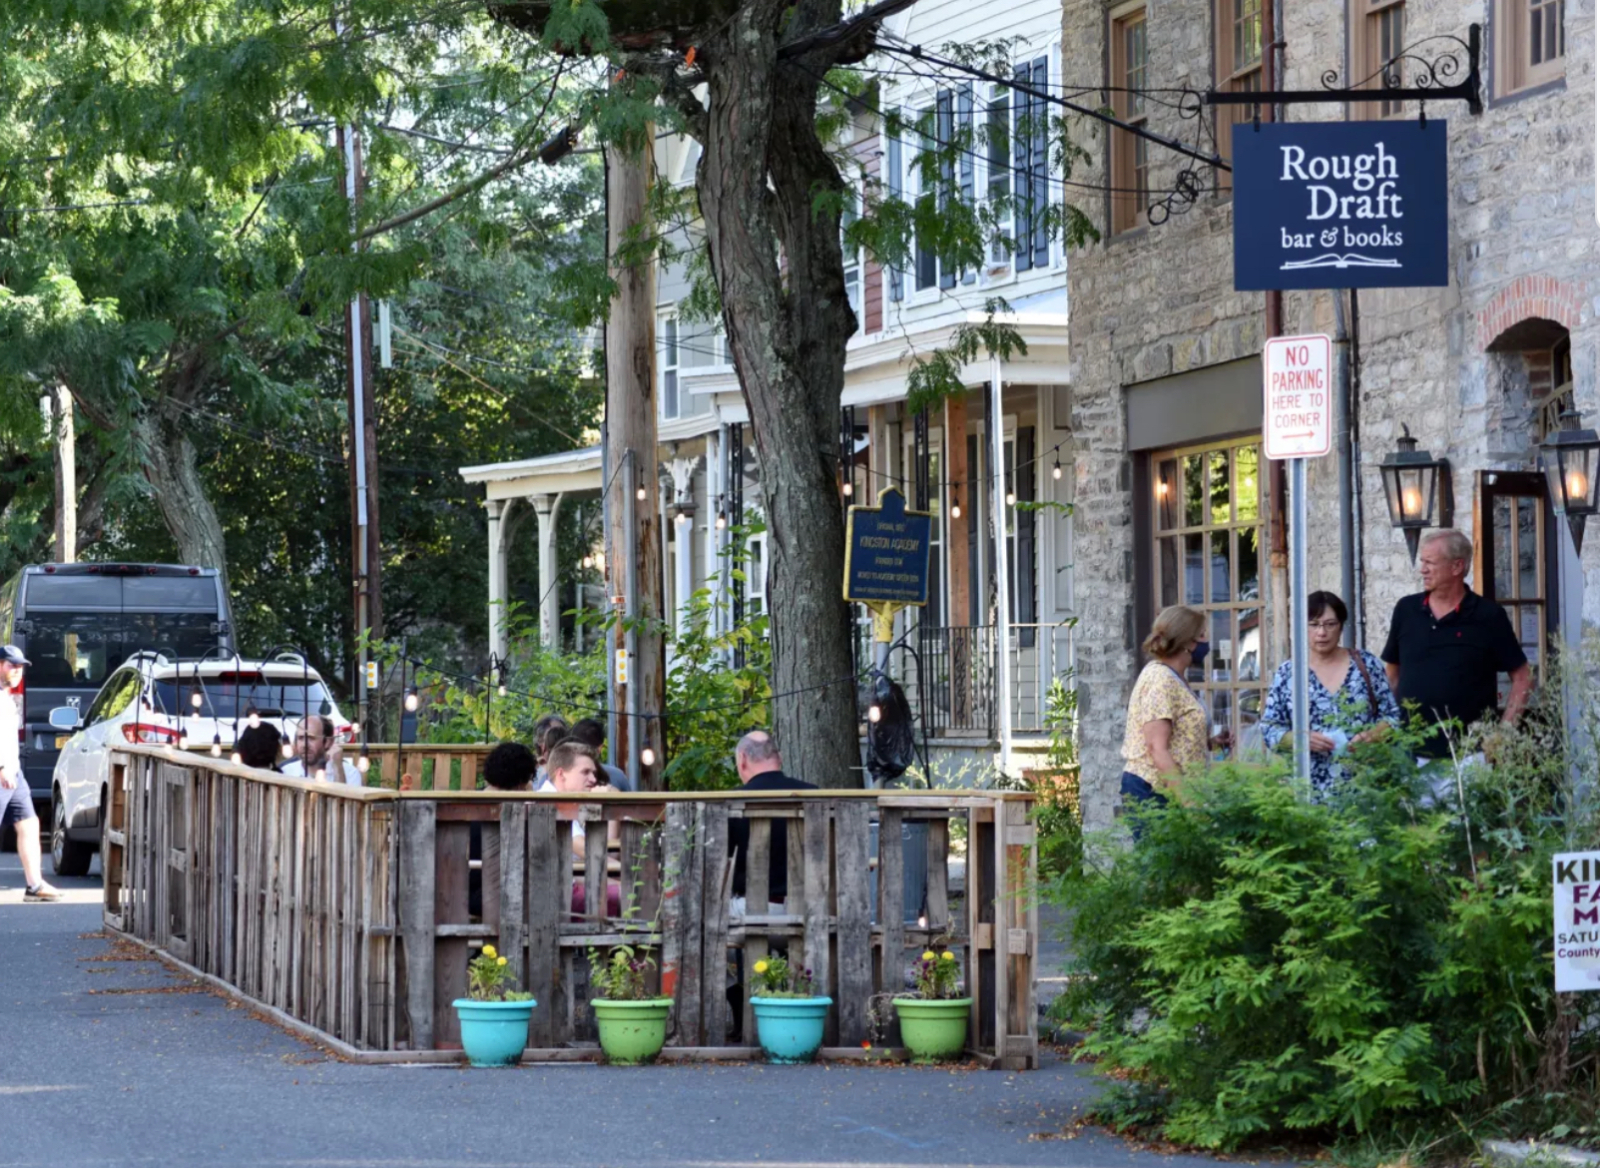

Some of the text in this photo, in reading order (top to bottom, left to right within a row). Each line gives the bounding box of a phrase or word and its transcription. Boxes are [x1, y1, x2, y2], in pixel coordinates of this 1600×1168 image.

[1279, 141, 1399, 191] Rough
[1306, 180, 1403, 220] Draft
[1280, 223, 1403, 248] bar & books
[1285, 345, 1309, 367] NO
[1272, 368, 1323, 392] PARKING
[1272, 392, 1323, 411] HERE TO
[1275, 412, 1320, 429] CORNER
[1557, 947, 1600, 958] County
